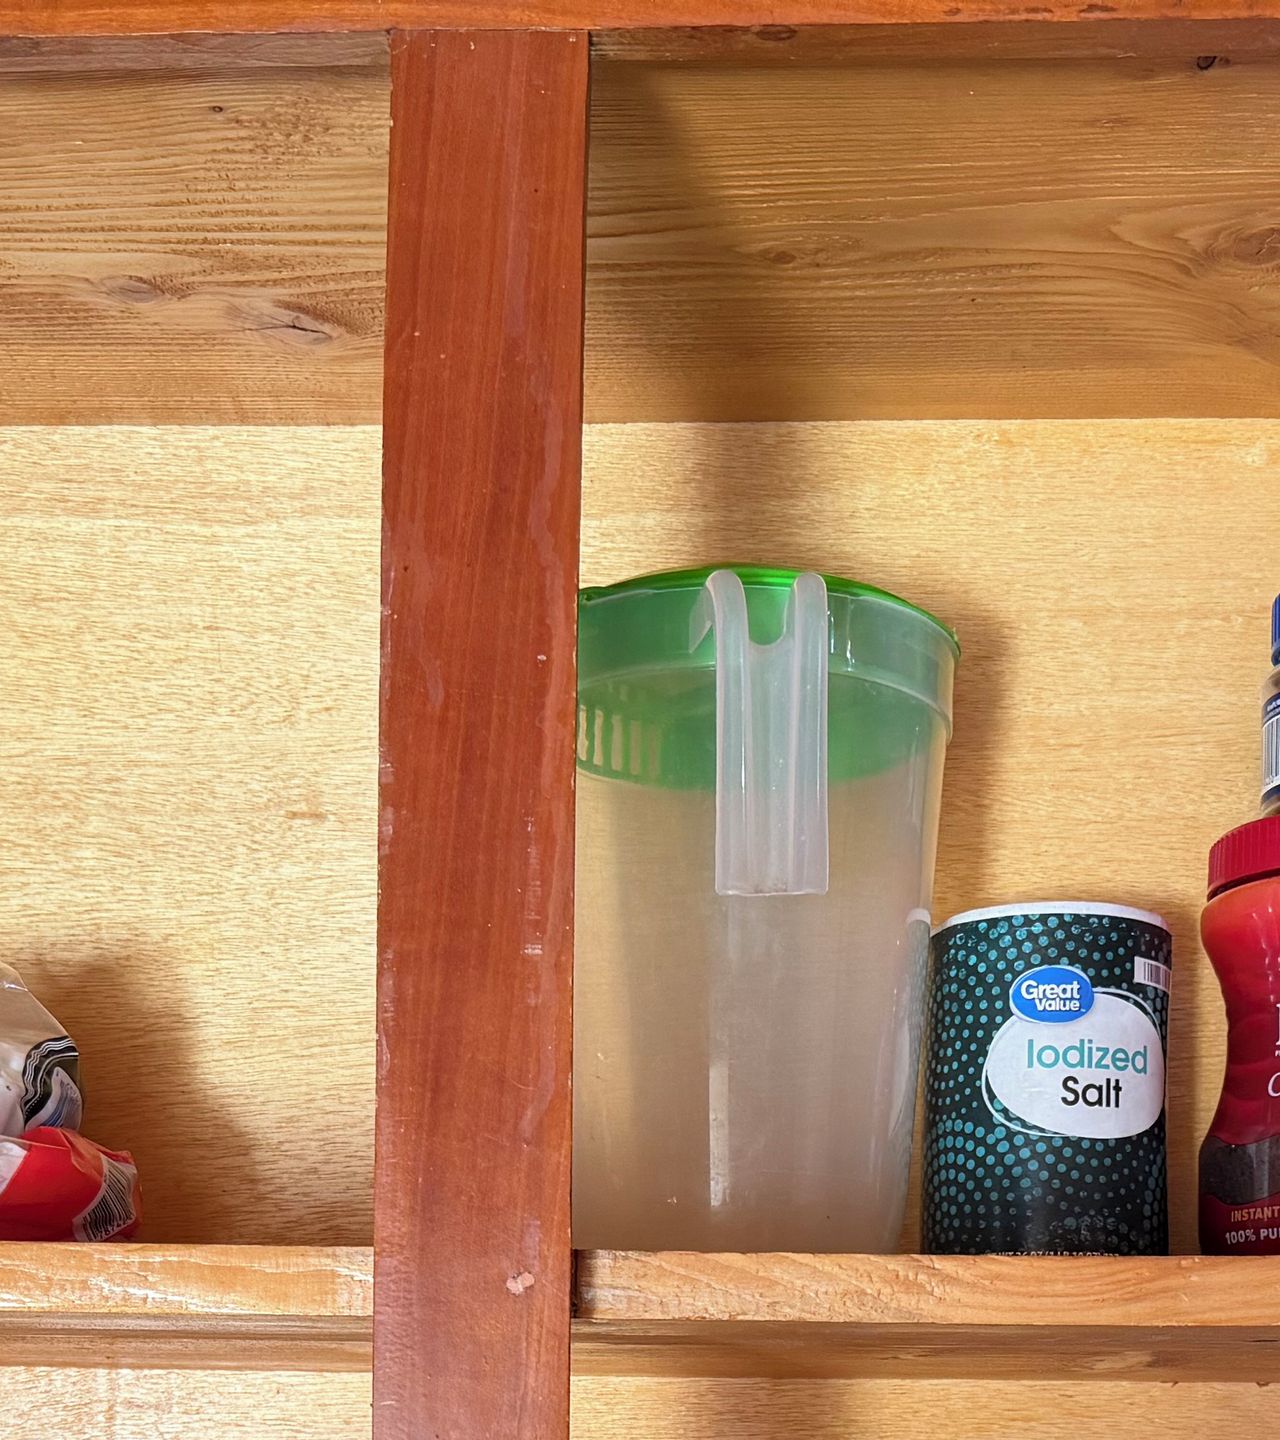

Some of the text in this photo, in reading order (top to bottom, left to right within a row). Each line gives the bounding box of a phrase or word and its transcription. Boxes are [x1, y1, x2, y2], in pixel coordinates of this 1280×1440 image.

[1021, 979, 1081, 1000] Great
[1035, 997, 1081, 1012] Value
[1026, 1038, 1148, 1075] Iodized
[1061, 1076, 1123, 1109] Salt
[1230, 1205, 1280, 1223] INSTANT
[1224, 1228, 1257, 1245] 100%
